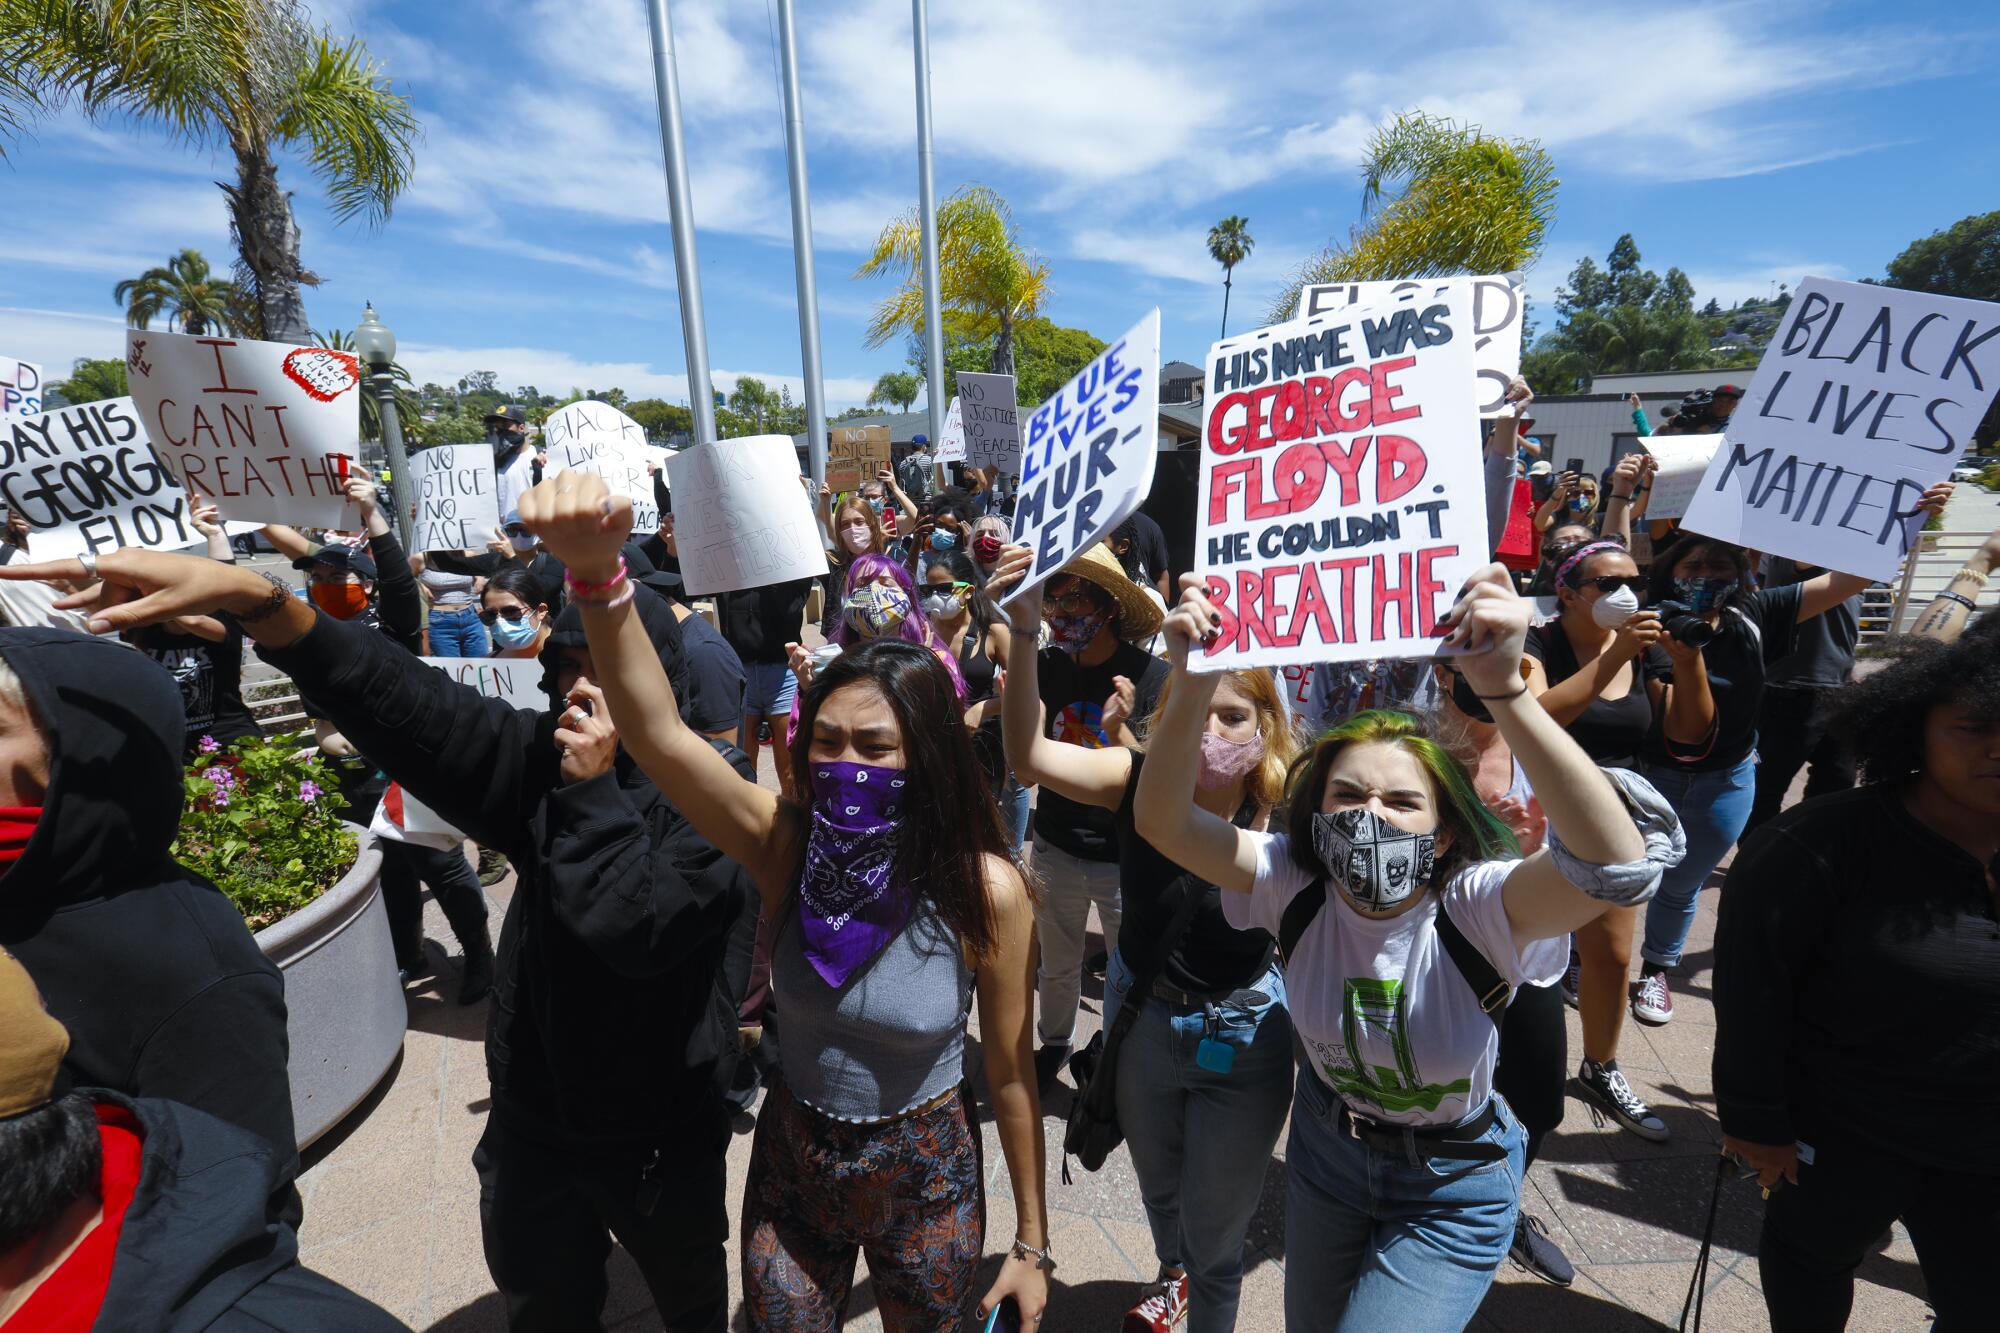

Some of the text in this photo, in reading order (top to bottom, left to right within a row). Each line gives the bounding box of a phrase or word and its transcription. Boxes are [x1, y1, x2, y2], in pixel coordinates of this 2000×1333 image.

[196, 340, 258, 395] I
[314, 352, 348, 385] Black
[1214, 304, 1454, 394] HIS NAME WAS
[1781, 292, 2000, 391] BLACK
[961, 382, 984, 401] NO
[969, 403, 1017, 425] JUSTICE
[1028, 339, 1127, 448] BLUE
[1207, 355, 1423, 456] GEORGE
[1759, 370, 1965, 455] LIVES
[62, 404, 136, 451] HIS
[159, 398, 289, 448] CAN'T
[832, 443, 874, 457] JUSTICE
[845, 430, 867, 442] NO
[963, 422, 984, 437] NO
[975, 438, 1019, 452] PEACE
[1022, 367, 1143, 485] LIVES
[426, 446, 454, 472] NO
[860, 460, 885, 480] EAC
[973, 452, 1008, 468] FTP
[1013, 425, 1142, 543] MUR-
[1208, 434, 1445, 526] FLOYD.
[79, 497, 188, 555] FLOY
[425, 499, 456, 520] NO
[1715, 443, 1926, 555] MATTER
[687, 523, 807, 586] ATTER!
[1207, 500, 1450, 566] HE COULDN'T
[1203, 545, 1459, 657] BREATHE
